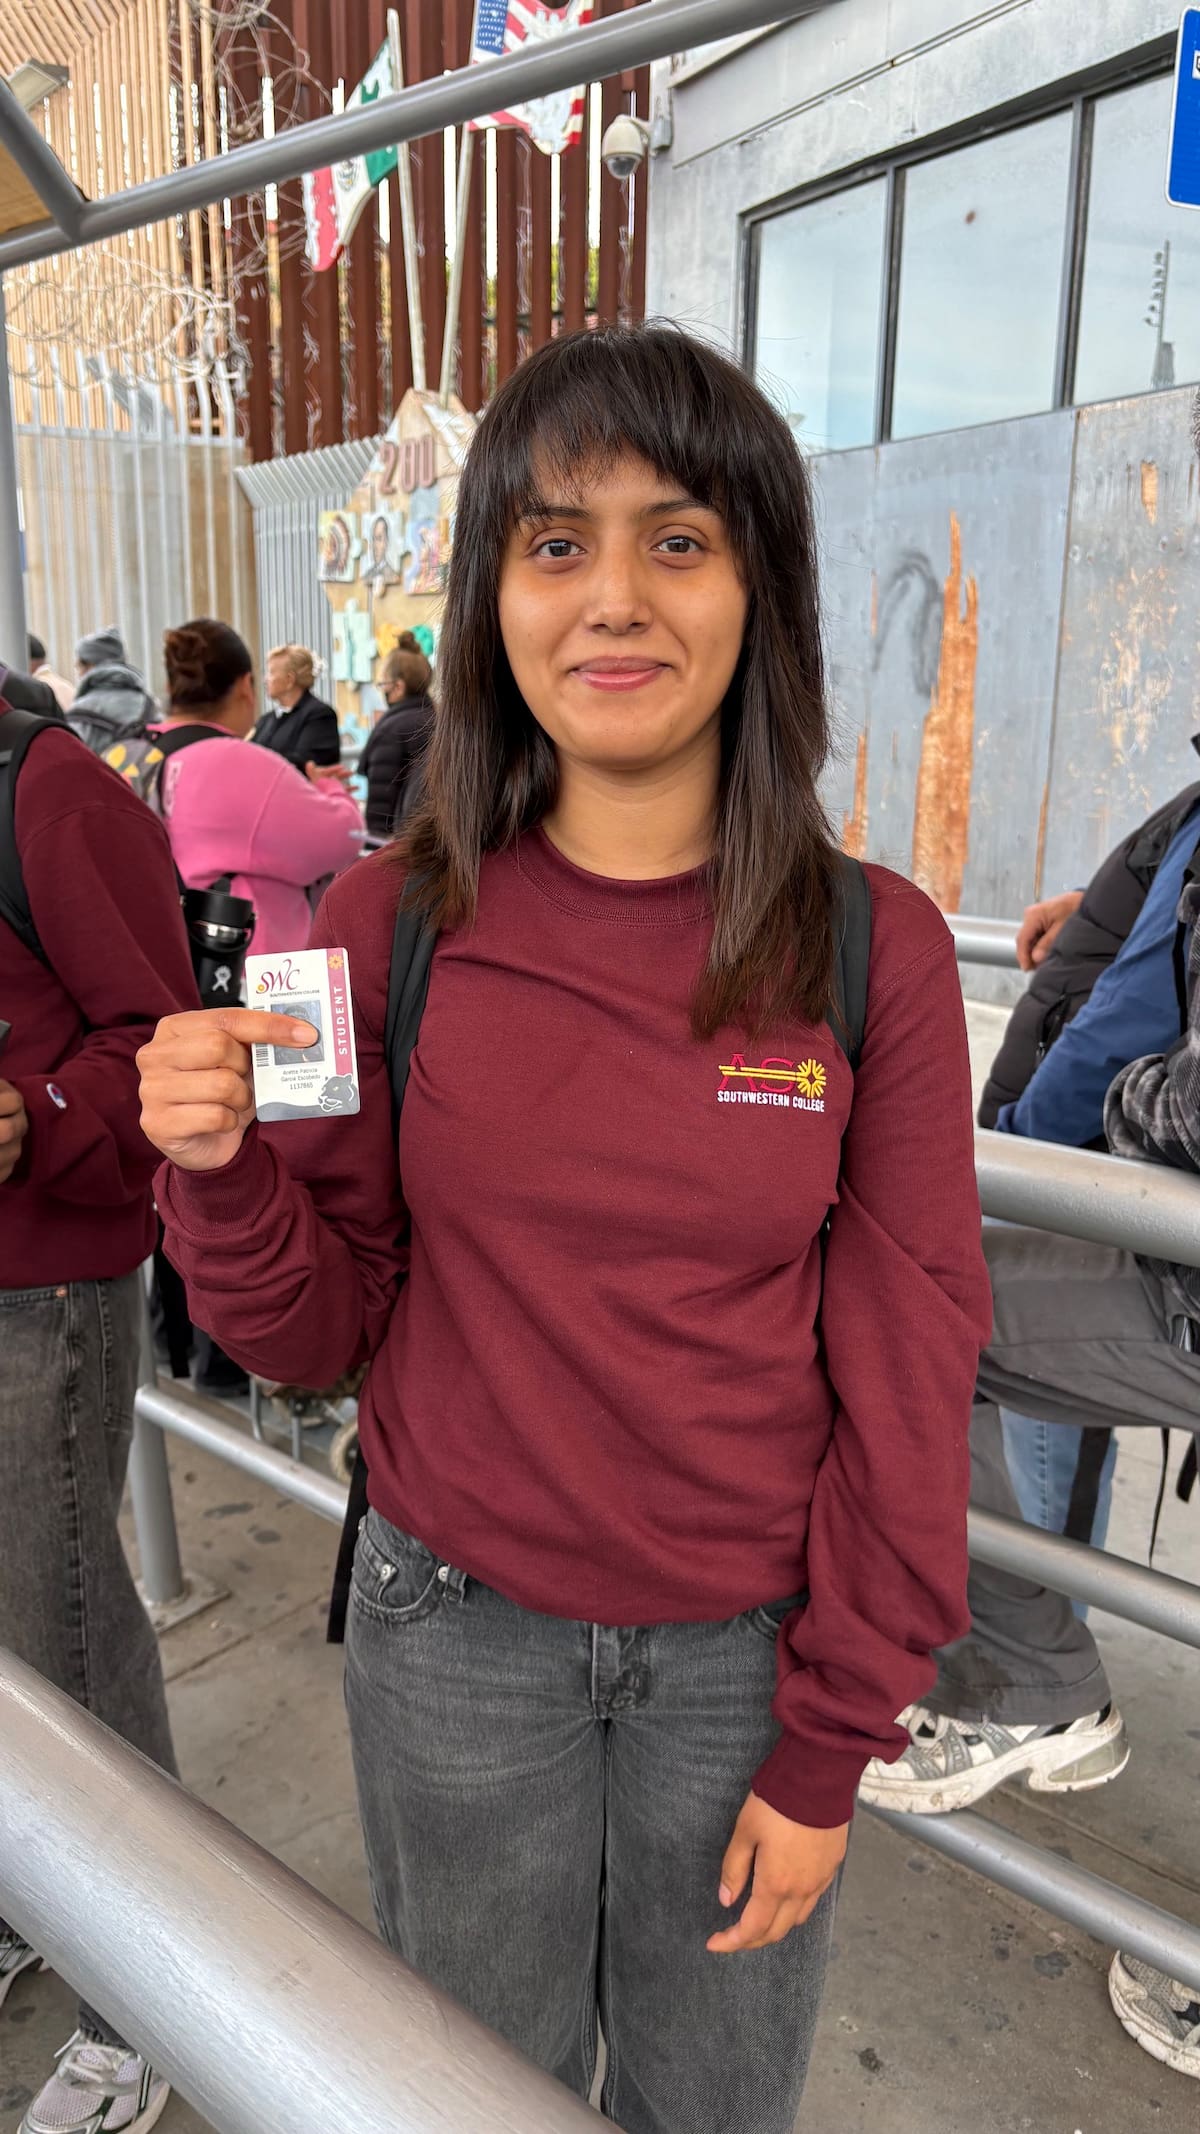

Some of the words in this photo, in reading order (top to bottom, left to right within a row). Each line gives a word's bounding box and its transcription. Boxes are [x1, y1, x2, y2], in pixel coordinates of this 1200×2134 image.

[256, 959, 300, 994] SWC
[333, 986, 348, 1055] STUDENT
[717, 1090, 790, 1107] SOUTHWESTERN
[792, 1096, 825, 1113] COLLEGE
